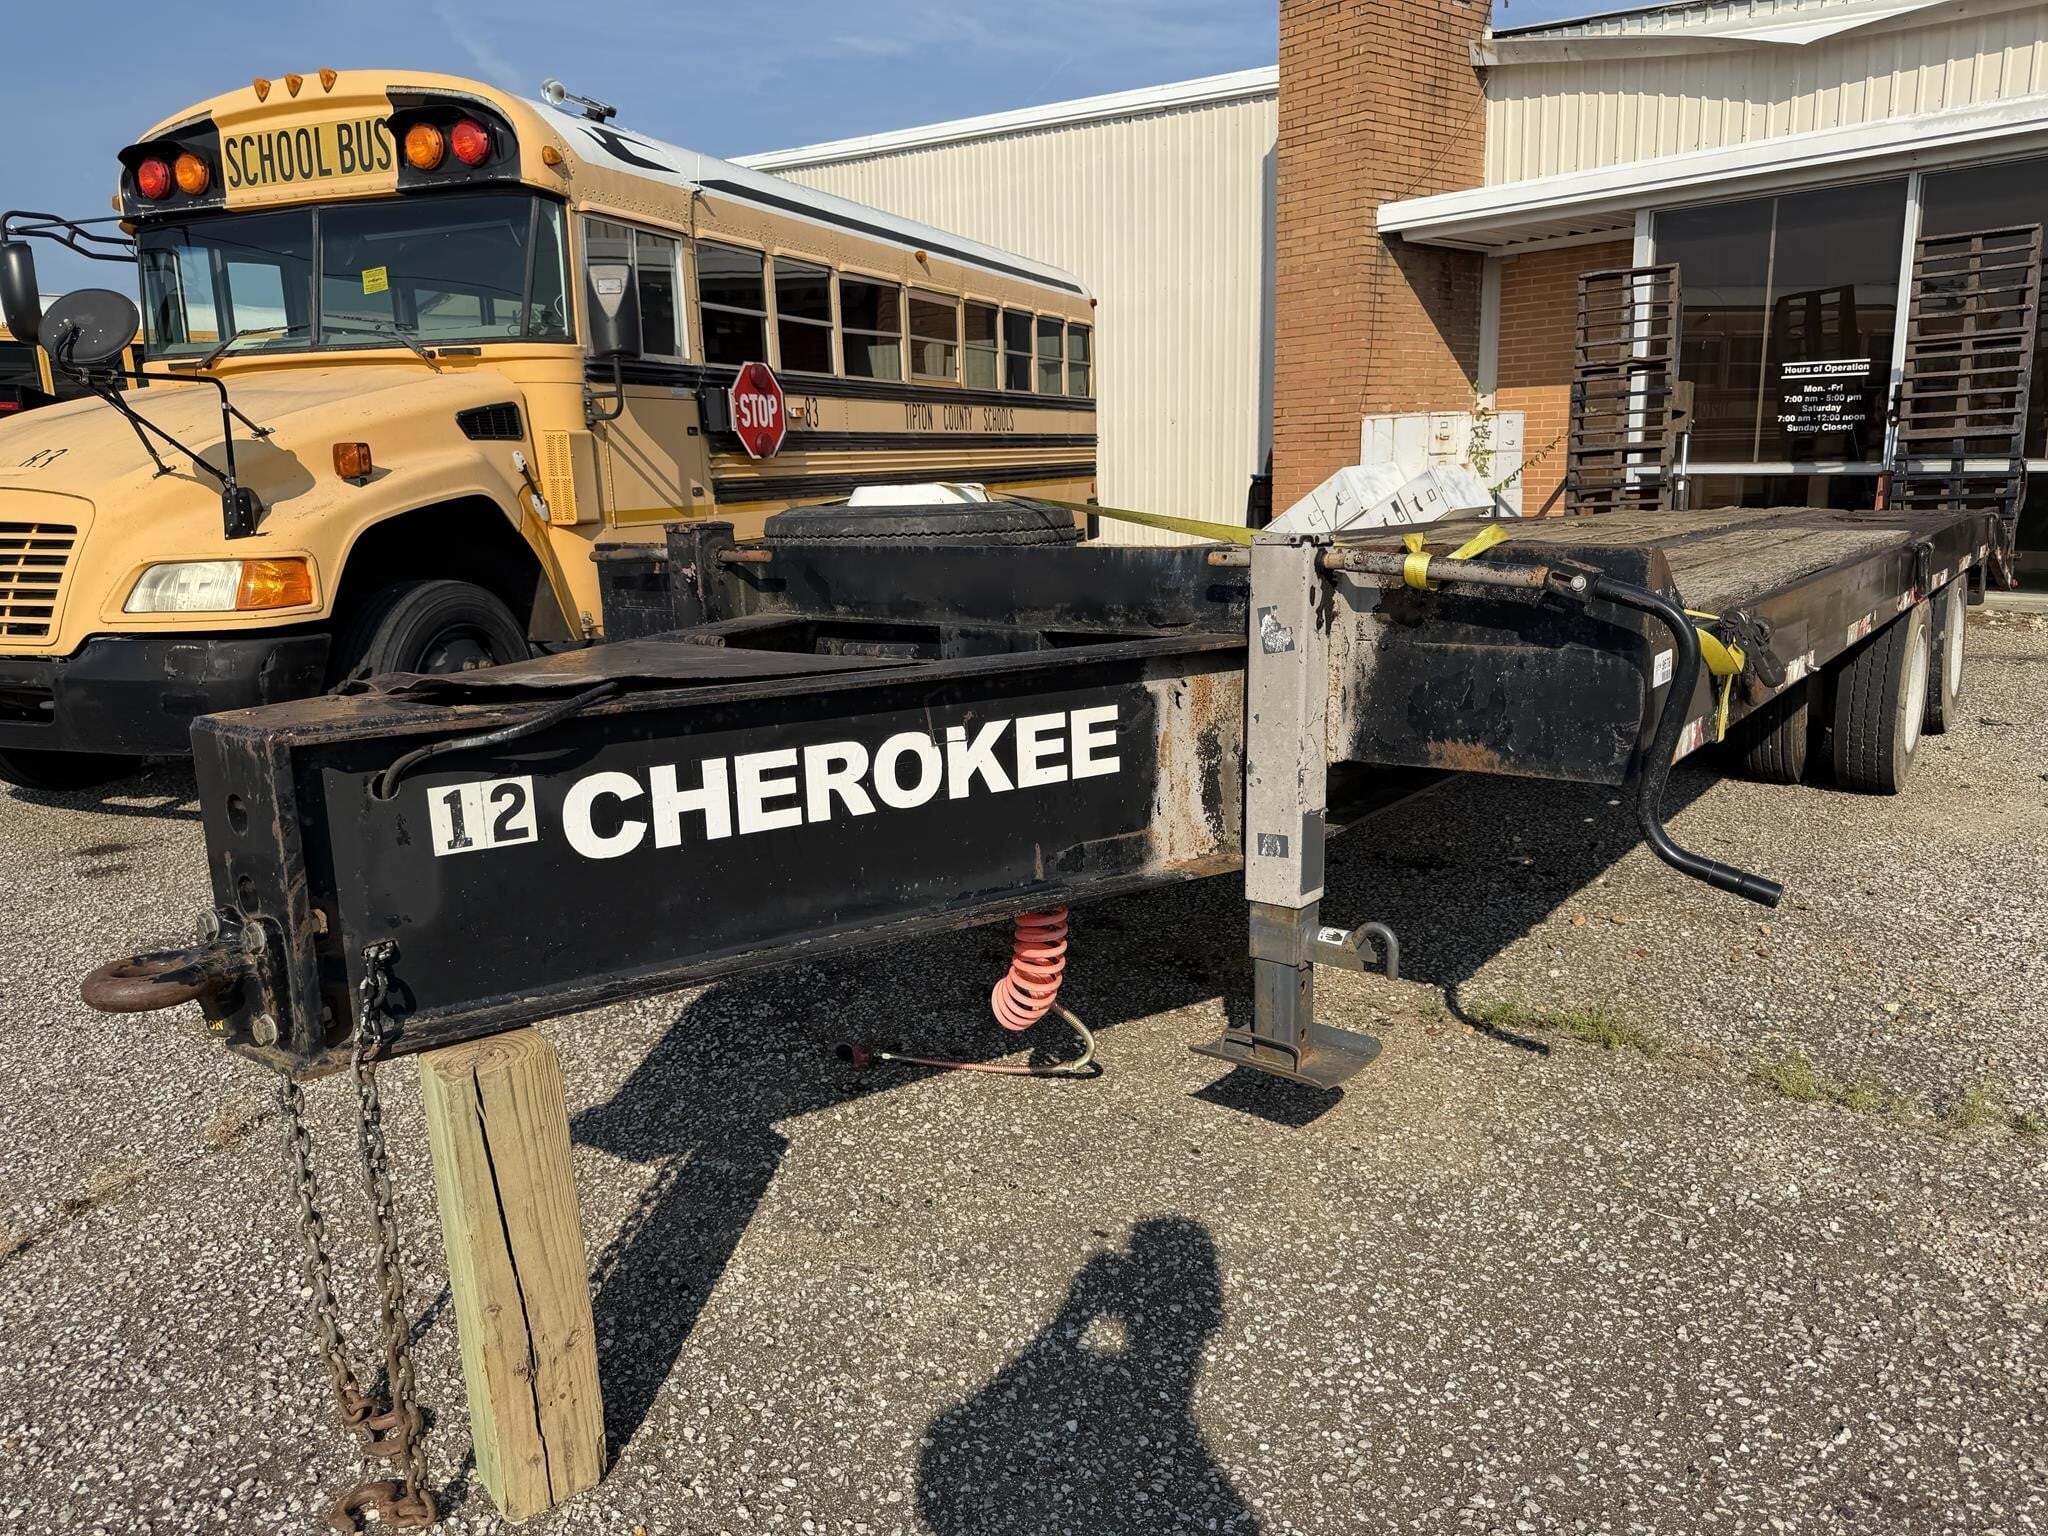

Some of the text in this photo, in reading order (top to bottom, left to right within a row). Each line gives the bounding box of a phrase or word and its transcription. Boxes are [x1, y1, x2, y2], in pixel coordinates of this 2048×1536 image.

[225, 117, 391, 188] SCHOOL BUS
[1784, 363, 1870, 374] Hours of Operation
[740, 393, 777, 428] STOP
[805, 396, 819, 428] 83
[1784, 395, 1803, 403] 7:00
[1826, 394, 1845, 402] 5:00
[1847, 394, 1862, 403] pm
[1802, 404, 1842, 413] Saturday
[904, 403, 1014, 432] TIPTON COUNTY SCHOOLS
[1787, 423, 1853, 432] Sunday Closed
[562, 704, 1120, 859] CHEROKEE
[442, 782, 530, 850] 12
